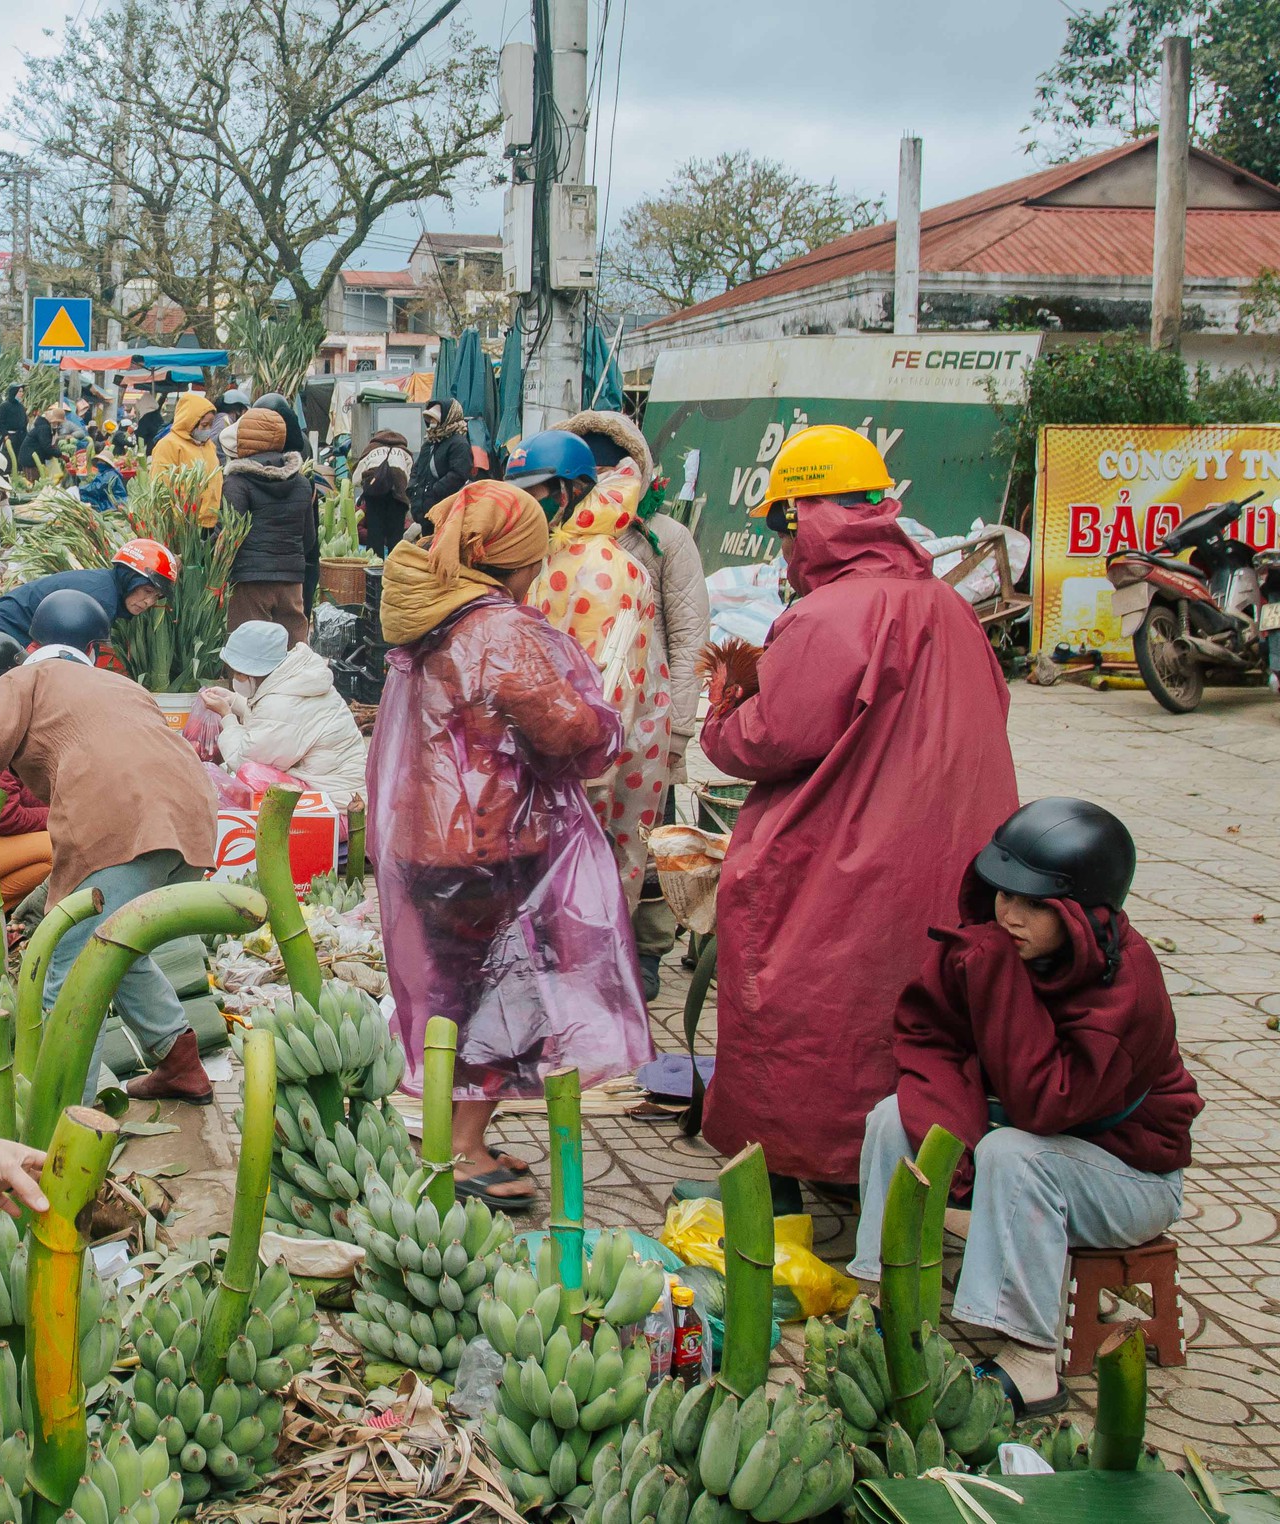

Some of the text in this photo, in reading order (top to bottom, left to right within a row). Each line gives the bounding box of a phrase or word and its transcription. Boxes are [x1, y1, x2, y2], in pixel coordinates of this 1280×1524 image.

[891, 350, 1021, 370] FE CREDIT
[1098, 441, 1183, 481] CÔNG
[1191, 449, 1234, 481] TY
[1066, 488, 1183, 557] BẢO
